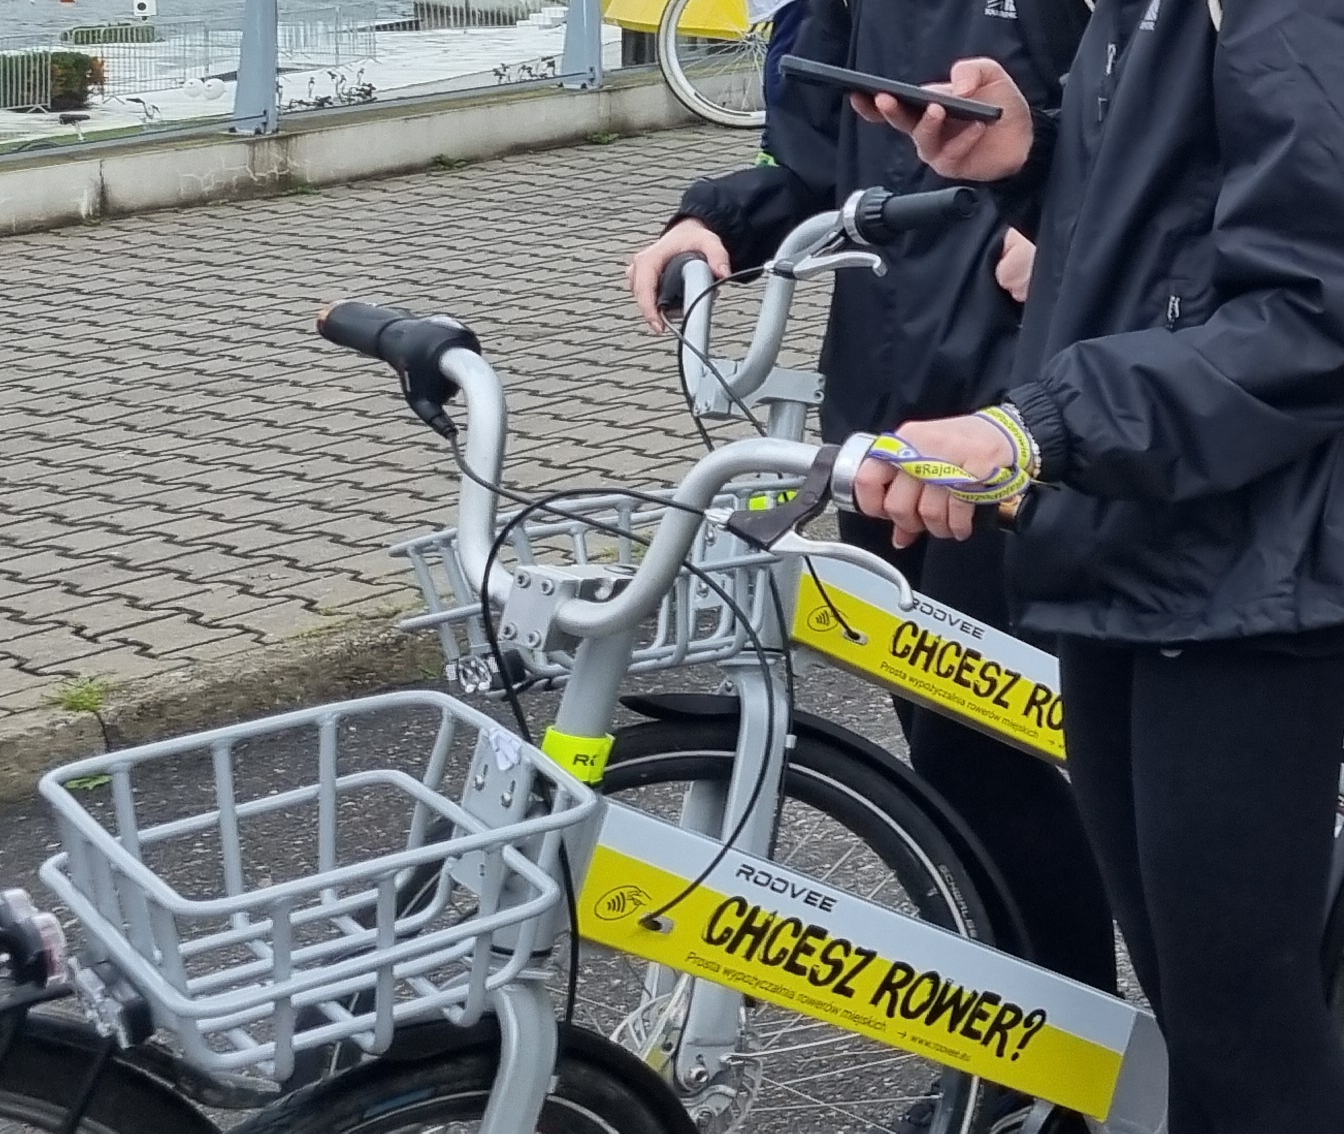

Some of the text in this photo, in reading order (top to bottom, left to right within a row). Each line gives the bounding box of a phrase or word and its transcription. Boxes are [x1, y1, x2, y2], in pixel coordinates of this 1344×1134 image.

[912, 598, 986, 640] ROOVEE
[880, 661, 907, 682] Prosta
[966, 700, 1001, 722] rowerów
[890, 620, 1022, 709] CHCESZ
[735, 864, 838, 913] ROOVEE
[685, 951, 721, 974] Prosta
[702, 896, 1047, 1061] CHCESZ ROWER?
